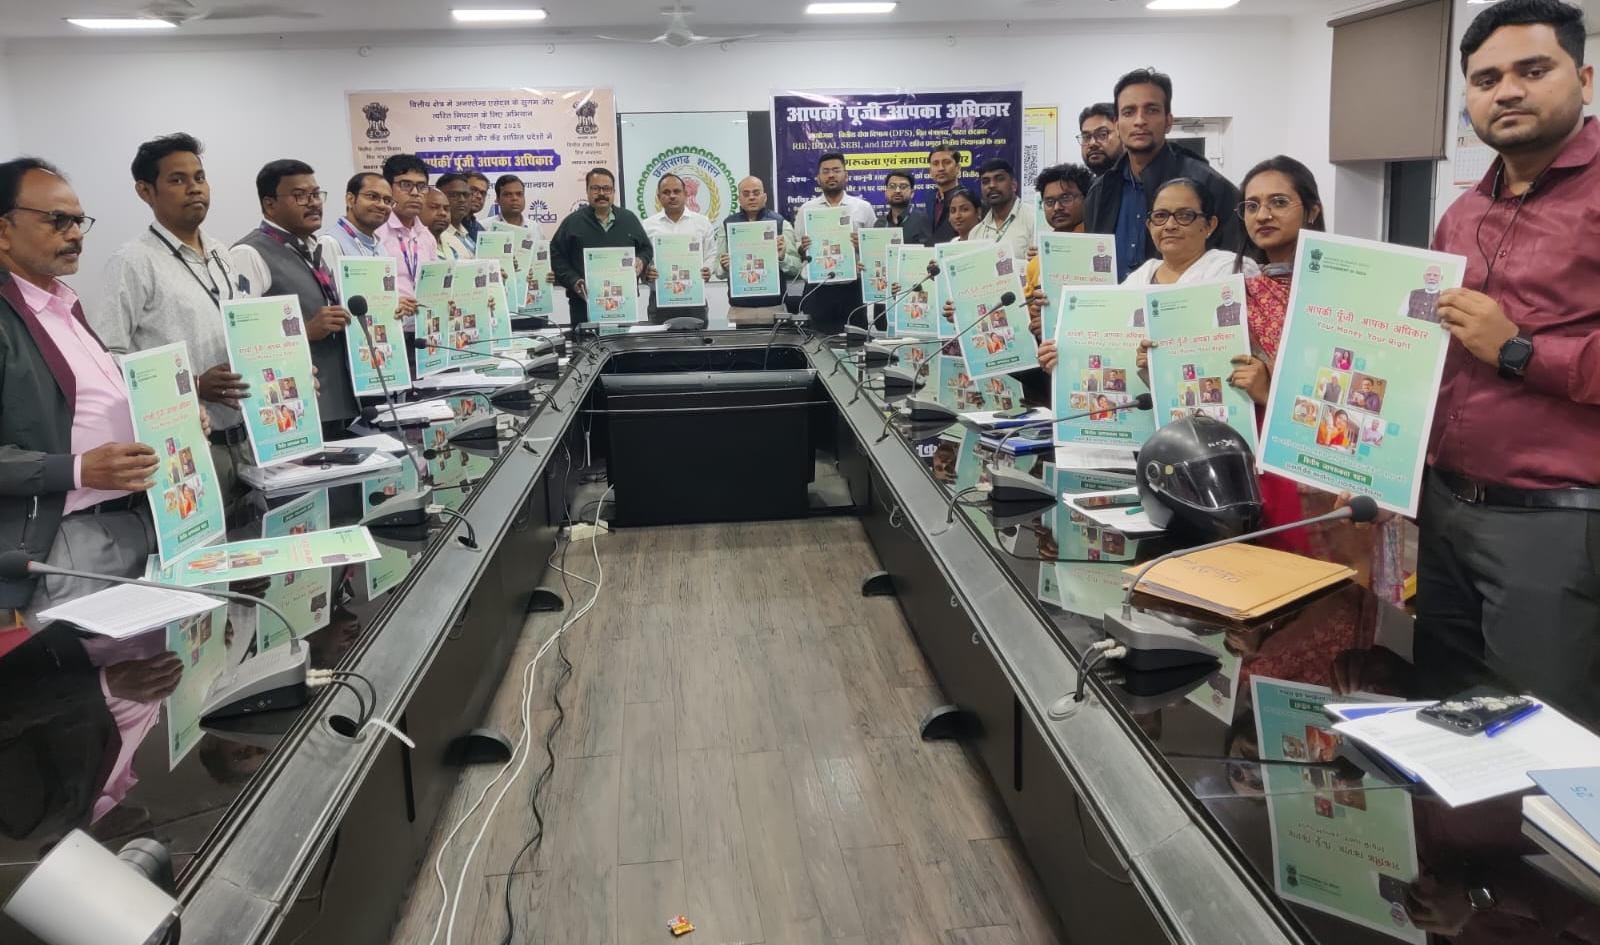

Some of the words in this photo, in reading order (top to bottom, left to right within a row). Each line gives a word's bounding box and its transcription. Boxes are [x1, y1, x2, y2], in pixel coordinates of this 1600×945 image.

[409, 99, 430, 108] वित्तीय
[512, 98, 519, 106] के
[542, 97, 554, 105] और
[481, 110, 487, 118] के
[489, 109, 503, 117] लिए
[506, 109, 533, 118] अभियान
[786, 103, 843, 121] आपकी
[846, 101, 882, 126] पूंजी
[886, 104, 942, 120] आपका
[946, 100, 1012, 118] अधिकार
[840, 141, 863, 149] SEBI,
[865, 140, 879, 148] and
[881, 140, 908, 148] IEPFA
[424, 155, 450, 168] पकी
[454, 154, 474, 171] पूंजी
[478, 155, 511, 167] आपका
[515, 153, 554, 167] अधिकार
[697, 158, 721, 178] शासन
[845, 158, 881, 167] गरूकता
[883, 154, 897, 166] एवं
[899, 157, 931, 166] समाधा
[1306, 303, 1332, 316] आपकी
[1361, 318, 1389, 330] आपका
[1393, 324, 1430, 339] अधिकार
[1368, 332, 1386, 343] Your
[1389, 338, 1411, 349] Right
